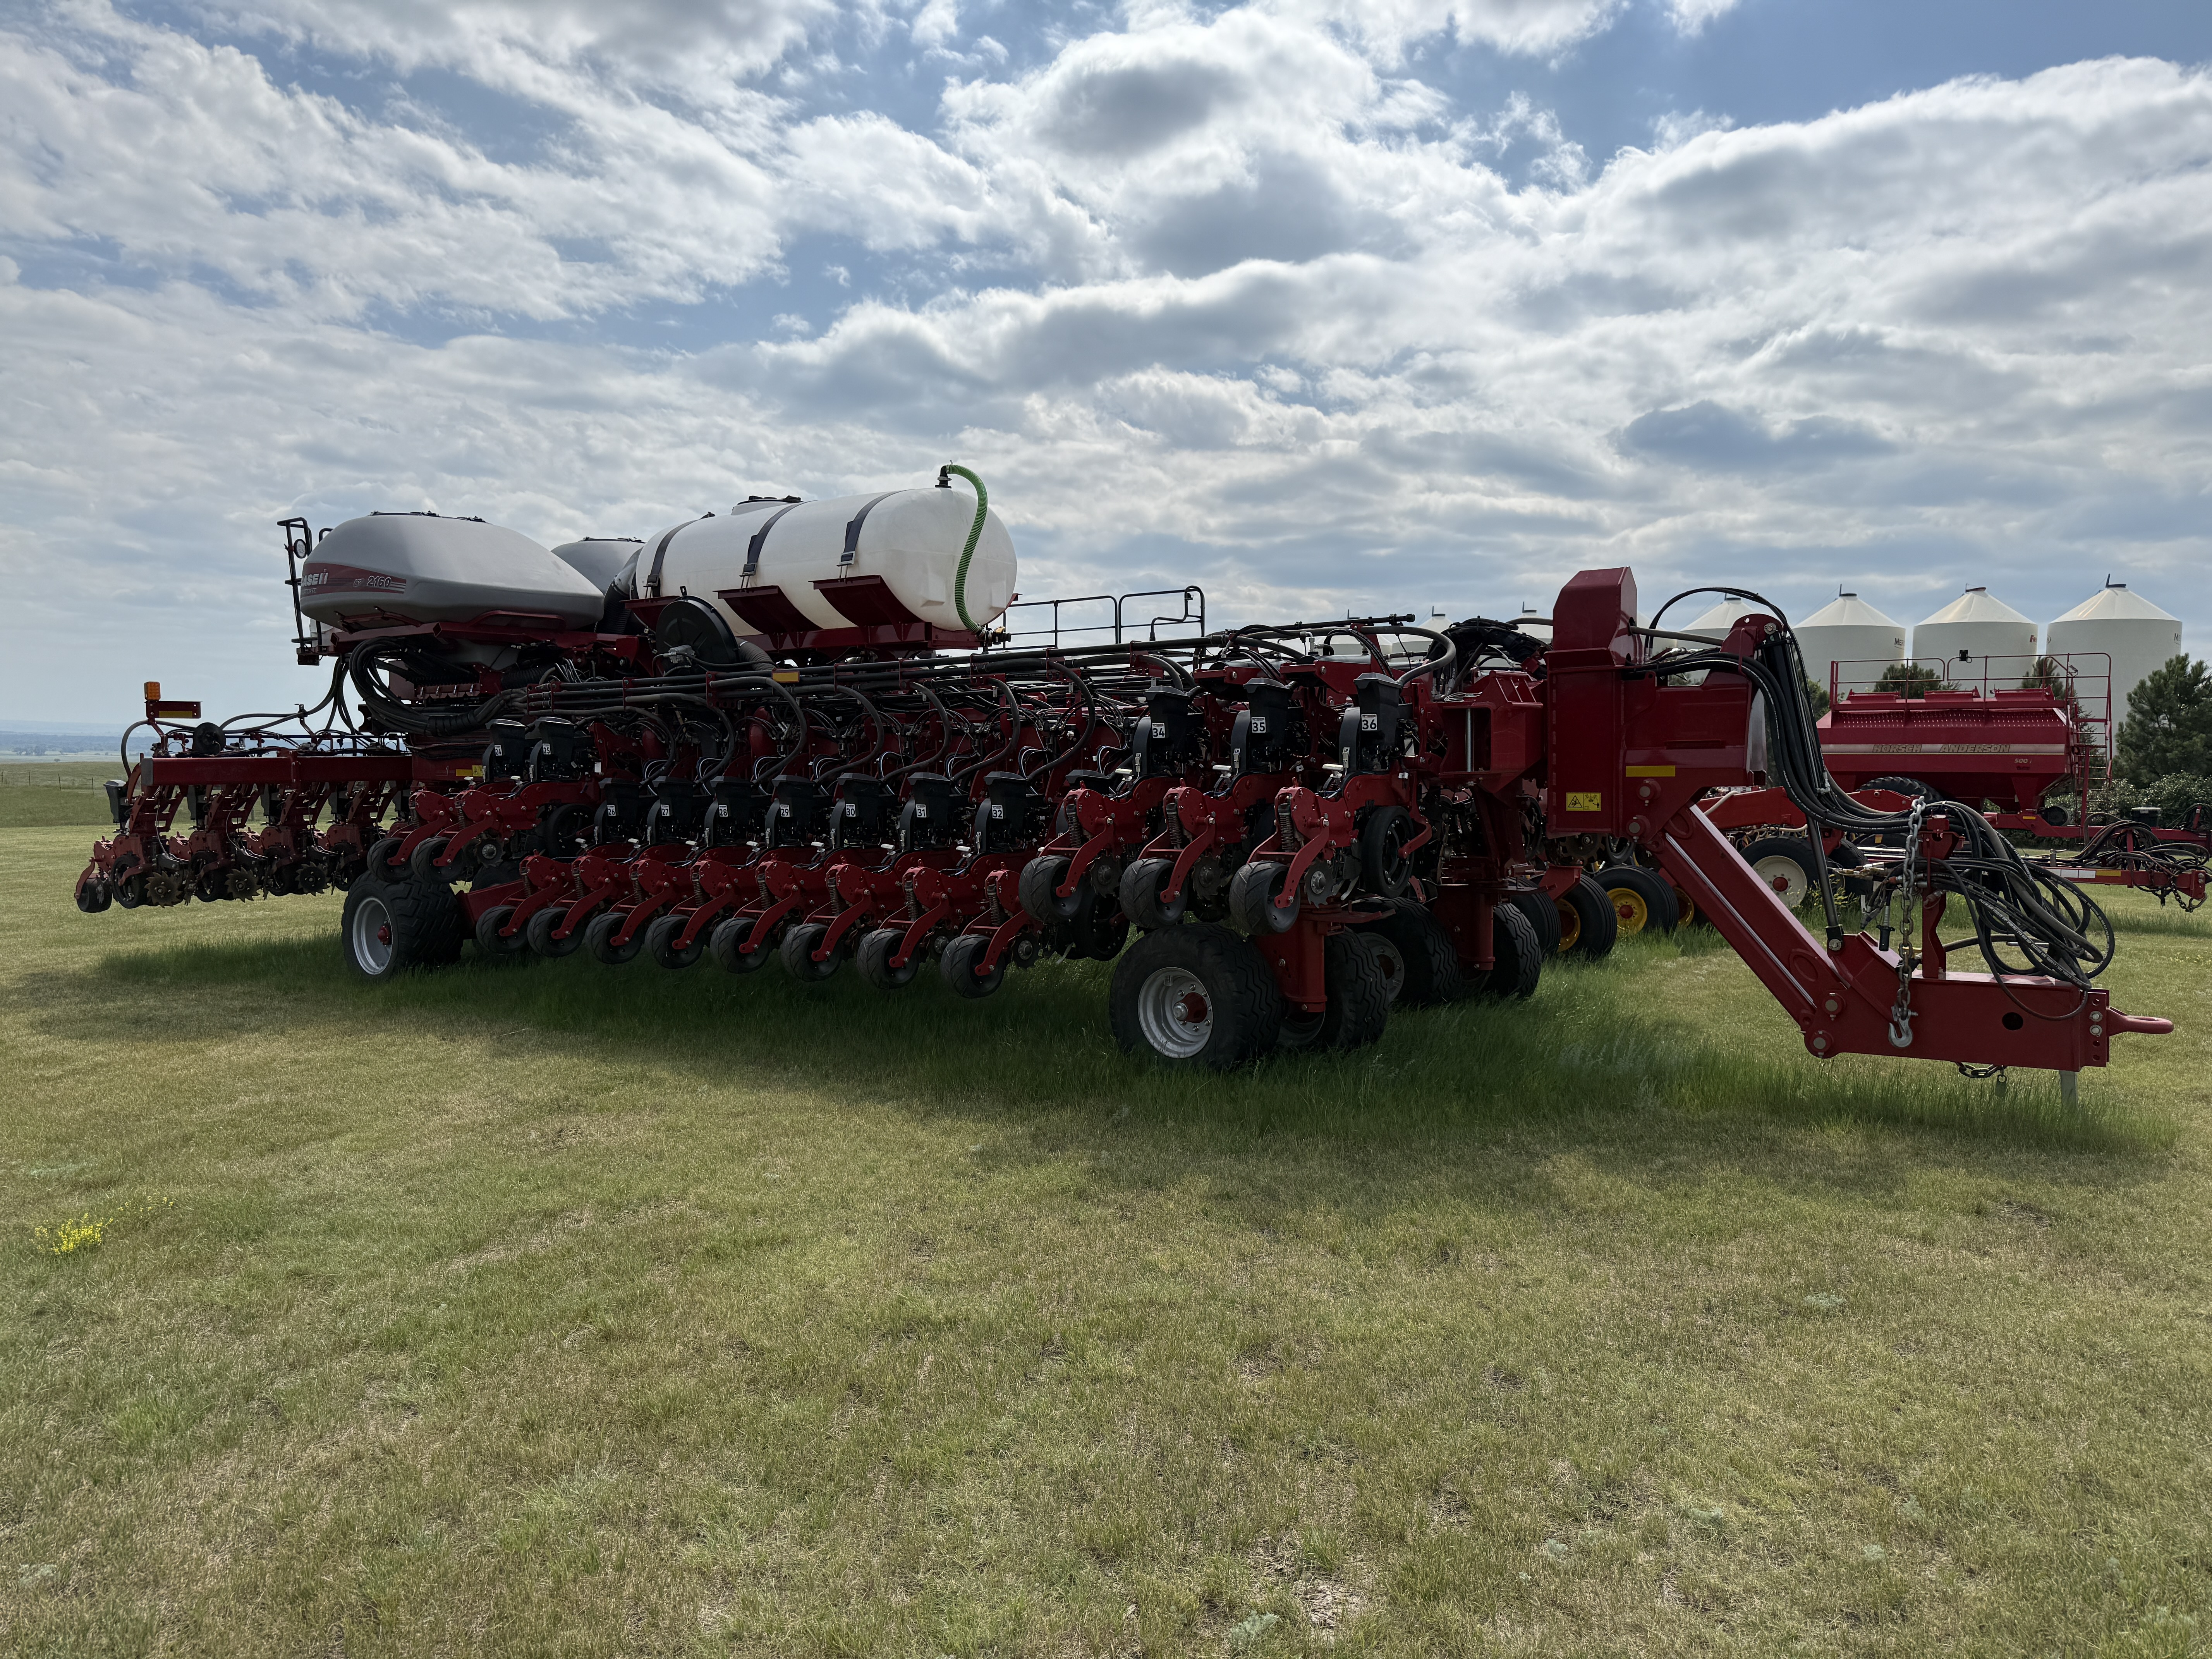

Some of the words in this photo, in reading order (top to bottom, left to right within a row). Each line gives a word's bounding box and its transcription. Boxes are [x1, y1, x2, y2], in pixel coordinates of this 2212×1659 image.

[367, 575, 392, 587] 2160
[1252, 722, 1265, 732] 35
[1362, 719, 1376, 730] 36
[1153, 728, 1165, 737] 34
[1872, 744, 1922, 752] HORSCH
[1939, 744, 2010, 752] ANDERSON
[917, 809, 925, 817] 31
[993, 810, 1002, 818] 32
